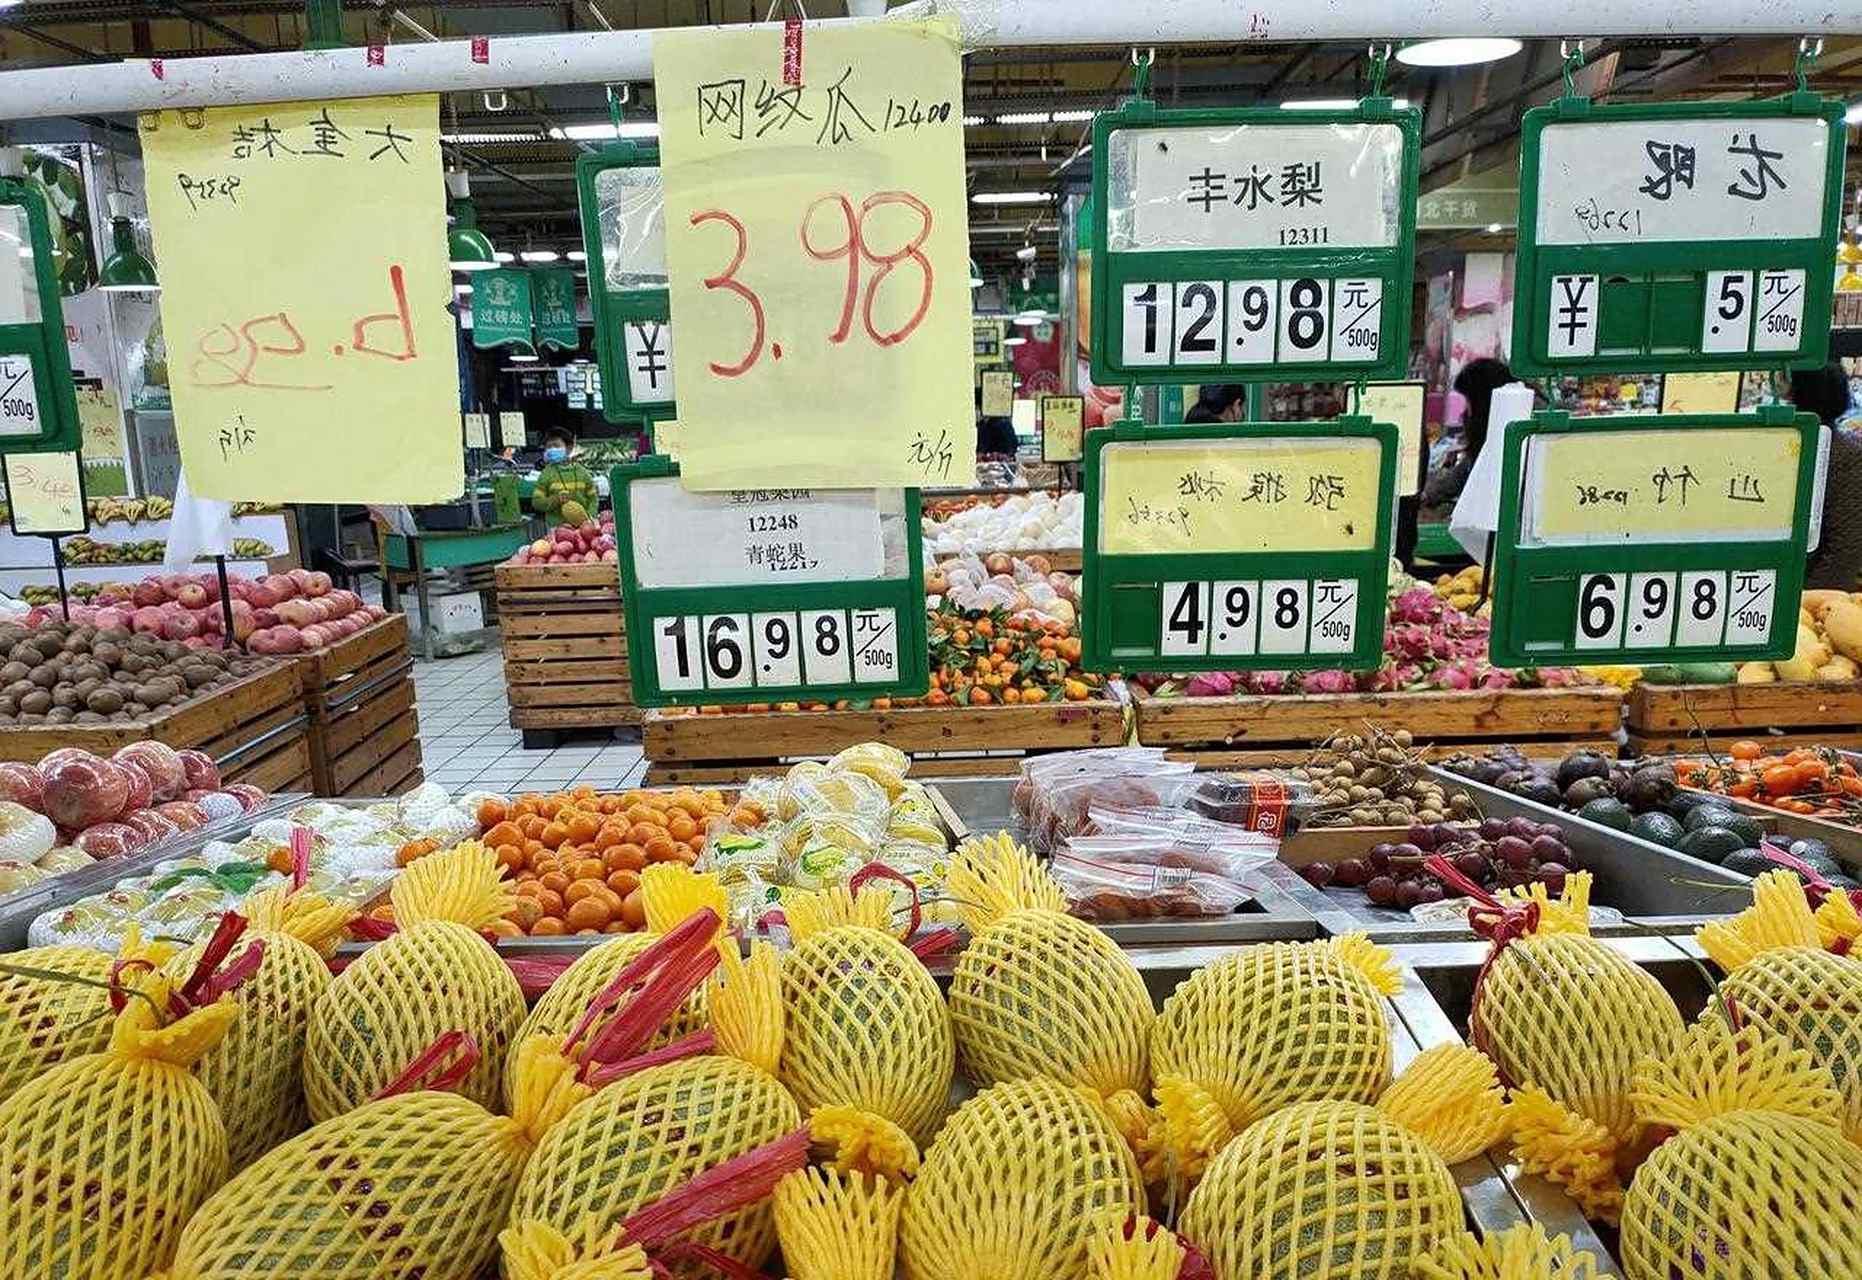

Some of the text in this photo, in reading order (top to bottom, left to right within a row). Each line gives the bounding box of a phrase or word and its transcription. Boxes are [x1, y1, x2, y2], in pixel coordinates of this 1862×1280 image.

[698, 67, 876, 144] 网纹瓜
[1187, 161, 1323, 212] 丰水梨
[1279, 227, 1329, 246] 12311
[690, 191, 933, 377] 3.98
[1134, 279, 1325, 353] 12.98
[745, 541, 806, 564] 青蛇果
[748, 513, 798, 533] 12248
[1169, 582, 1300, 644] 4.98
[1580, 574, 1717, 639] 6.98
[664, 615, 841, 679] 16.98
